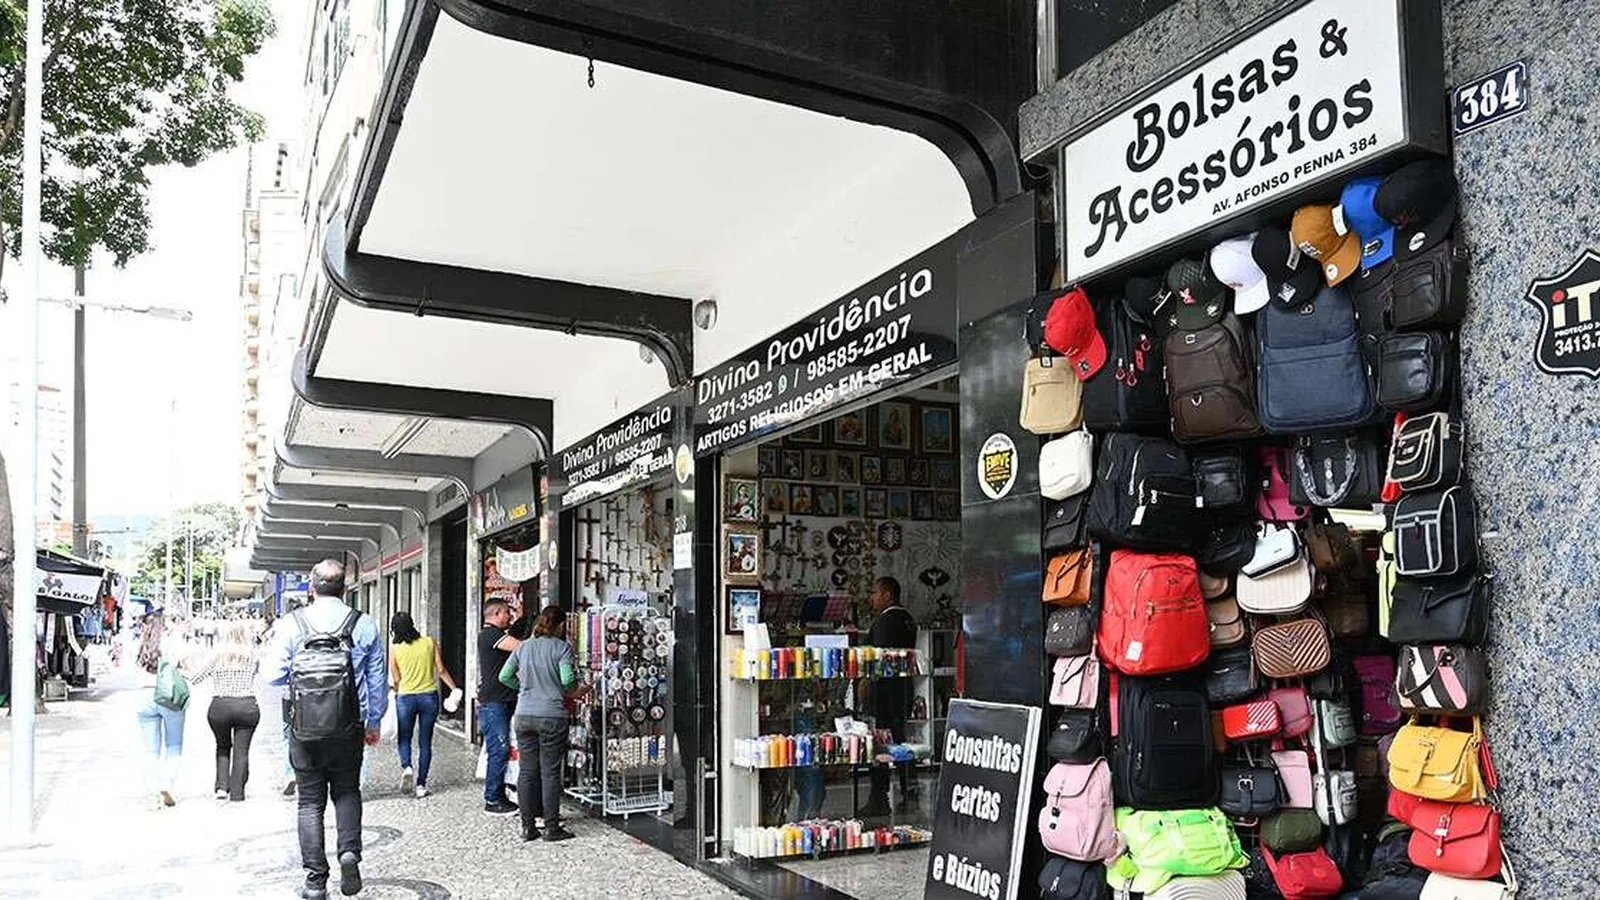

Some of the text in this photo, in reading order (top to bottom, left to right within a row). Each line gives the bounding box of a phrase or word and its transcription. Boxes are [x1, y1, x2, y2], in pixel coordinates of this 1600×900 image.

[1126, 18, 1350, 172] Bolsas &
[1460, 67, 1520, 124] 384
[1084, 77, 1374, 258] Acessórios
[1212, 133, 1378, 215] AV. AFONSO PENNA 384
[699, 267, 932, 405] Divina Providência
[706, 381, 773, 425] 3271-3582
[806, 313, 912, 382] 98585-2207
[696, 342, 932, 452] ARTIGOS RELIGIOSOS EM GERAL
[563, 405, 671, 472] Divina Providência
[945, 728, 1022, 774] Consultas
[951, 783, 1001, 822] cartas
[932, 852, 1001, 900] e Búzios
